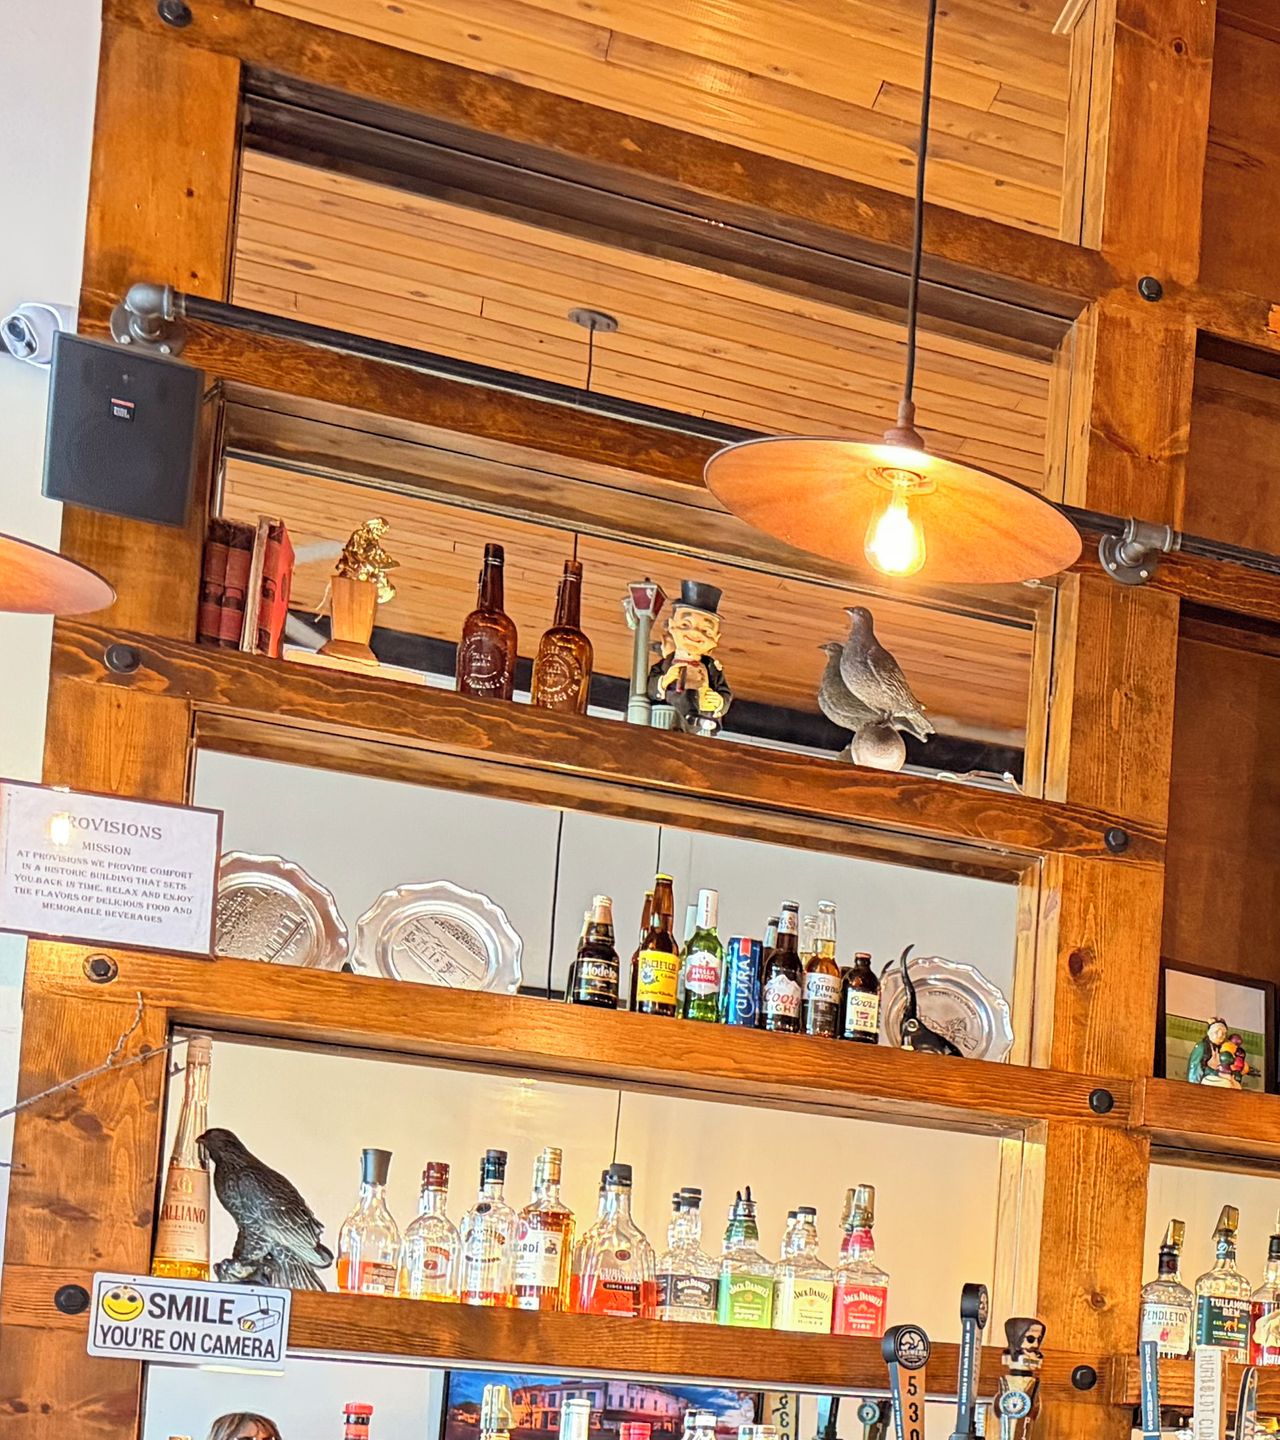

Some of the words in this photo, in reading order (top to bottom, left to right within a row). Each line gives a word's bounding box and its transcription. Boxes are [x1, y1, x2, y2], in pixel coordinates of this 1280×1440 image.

[56, 814, 162, 840] ROVISIONS
[82, 841, 132, 856] MISSION
[16, 850, 31, 859] AT
[33, 852, 88, 866] PROVISIONS
[108, 862, 148, 874] PROVIDE
[150, 867, 193, 880] COMFORT
[22, 862, 32, 871] IN
[34, 864, 41, 872] A
[44, 865, 87, 878] HISTORIC
[90, 871, 133, 884] BUILDING
[135, 877, 160, 888] THAT
[163, 880, 187, 890] SETS
[14, 887, 32, 895] THE
[35, 888, 79, 901] FLAVORS
[81, 895, 94, 903] OF
[96, 896, 143, 909] DELICIOUS
[146, 903, 170, 912] FOOD
[172, 906, 192, 915] AND
[65, 881, 75, 889] IN
[106, 885, 138, 896] RELAX
[141, 890, 160, 899] AND
[162, 893, 193, 903] ENJOY
[41, 902, 102, 916] MEMORABLE
[104, 910, 163, 924] BEVERAGES
[735, 959, 752, 1017] ULTRA
[148, 1292, 235, 1326] SMILE
[1143, 1308, 1188, 1323] PENDLETON
[100, 1324, 165, 1350] YOU'RE
[170, 1331, 196, 1352] ON
[201, 1333, 275, 1359] CAMERA
